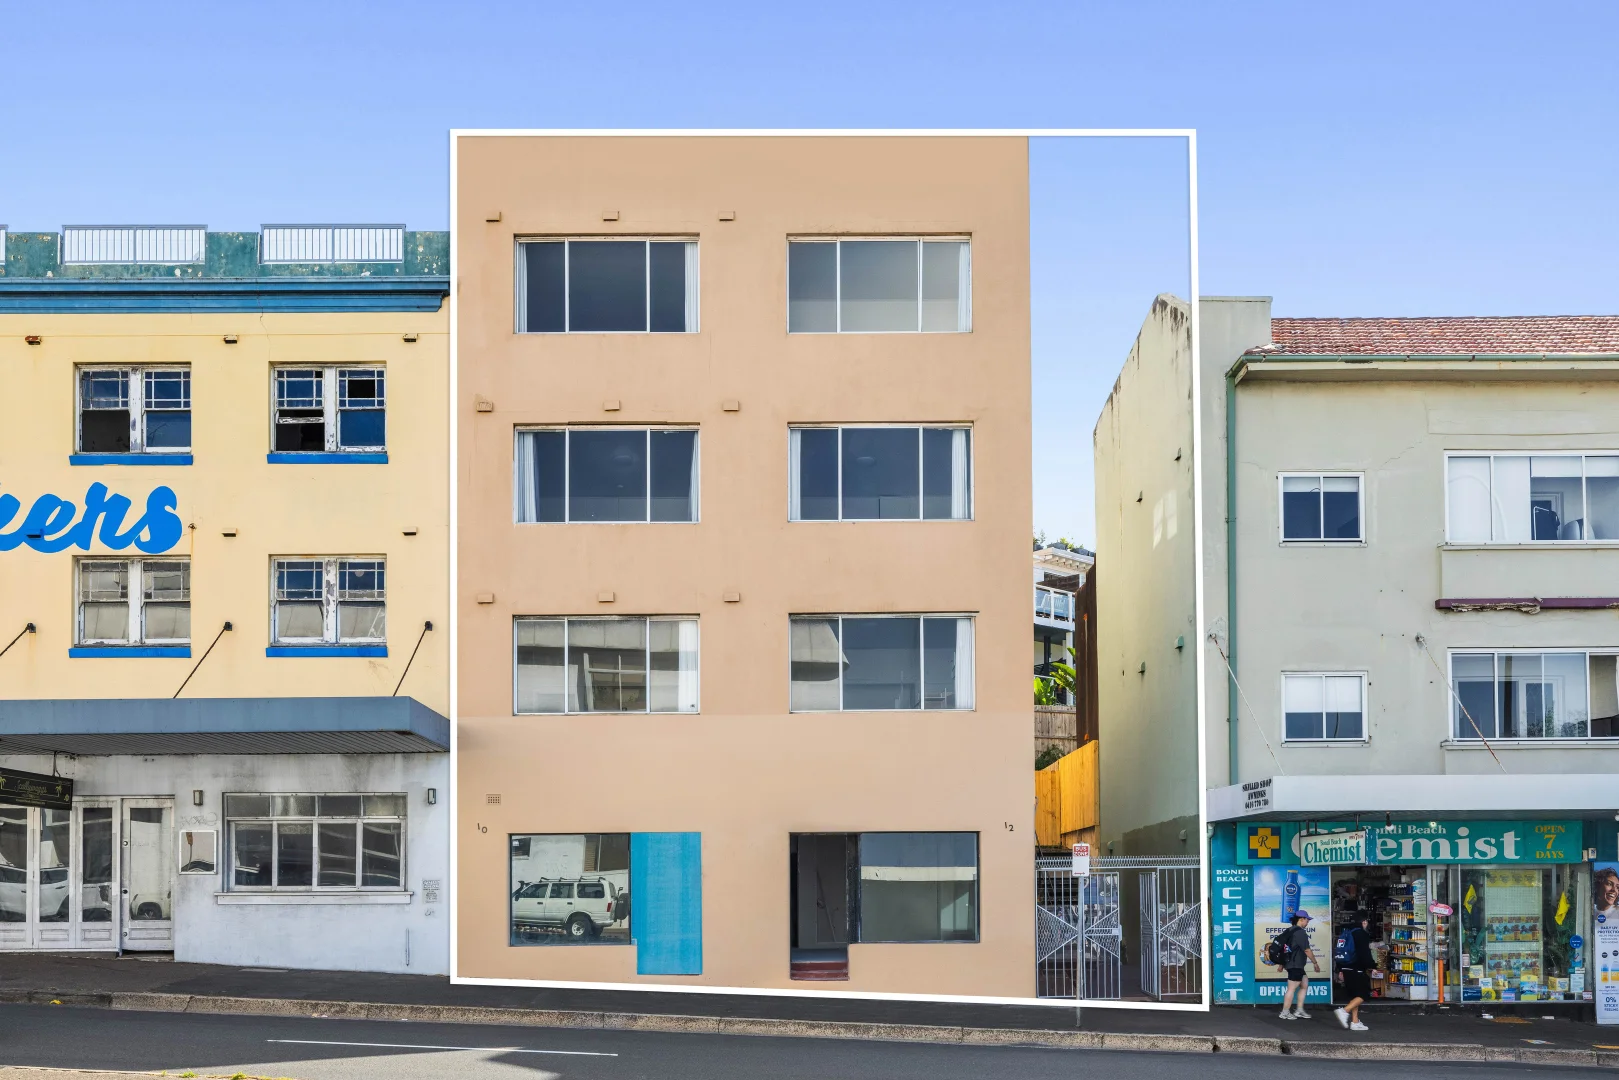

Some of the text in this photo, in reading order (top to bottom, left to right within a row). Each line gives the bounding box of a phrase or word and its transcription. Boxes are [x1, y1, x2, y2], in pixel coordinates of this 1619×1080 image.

[1242, 778, 1272, 792] SKILLED SHOP
[1004, 821, 1015, 832] 12
[1407, 825, 1447, 834] Beach
[1535, 825, 1566, 834] OPEN
[1291, 826, 1521, 860] Cemist
[1331, 837, 1342, 845] Beach
[1543, 834, 1557, 850] 7
[1303, 838, 1362, 864] Chemist
[1535, 850, 1565, 859] DAYS
[1222, 887, 1244, 1001] CHEMIST
[1260, 985, 1328, 997] OPEN AYS
